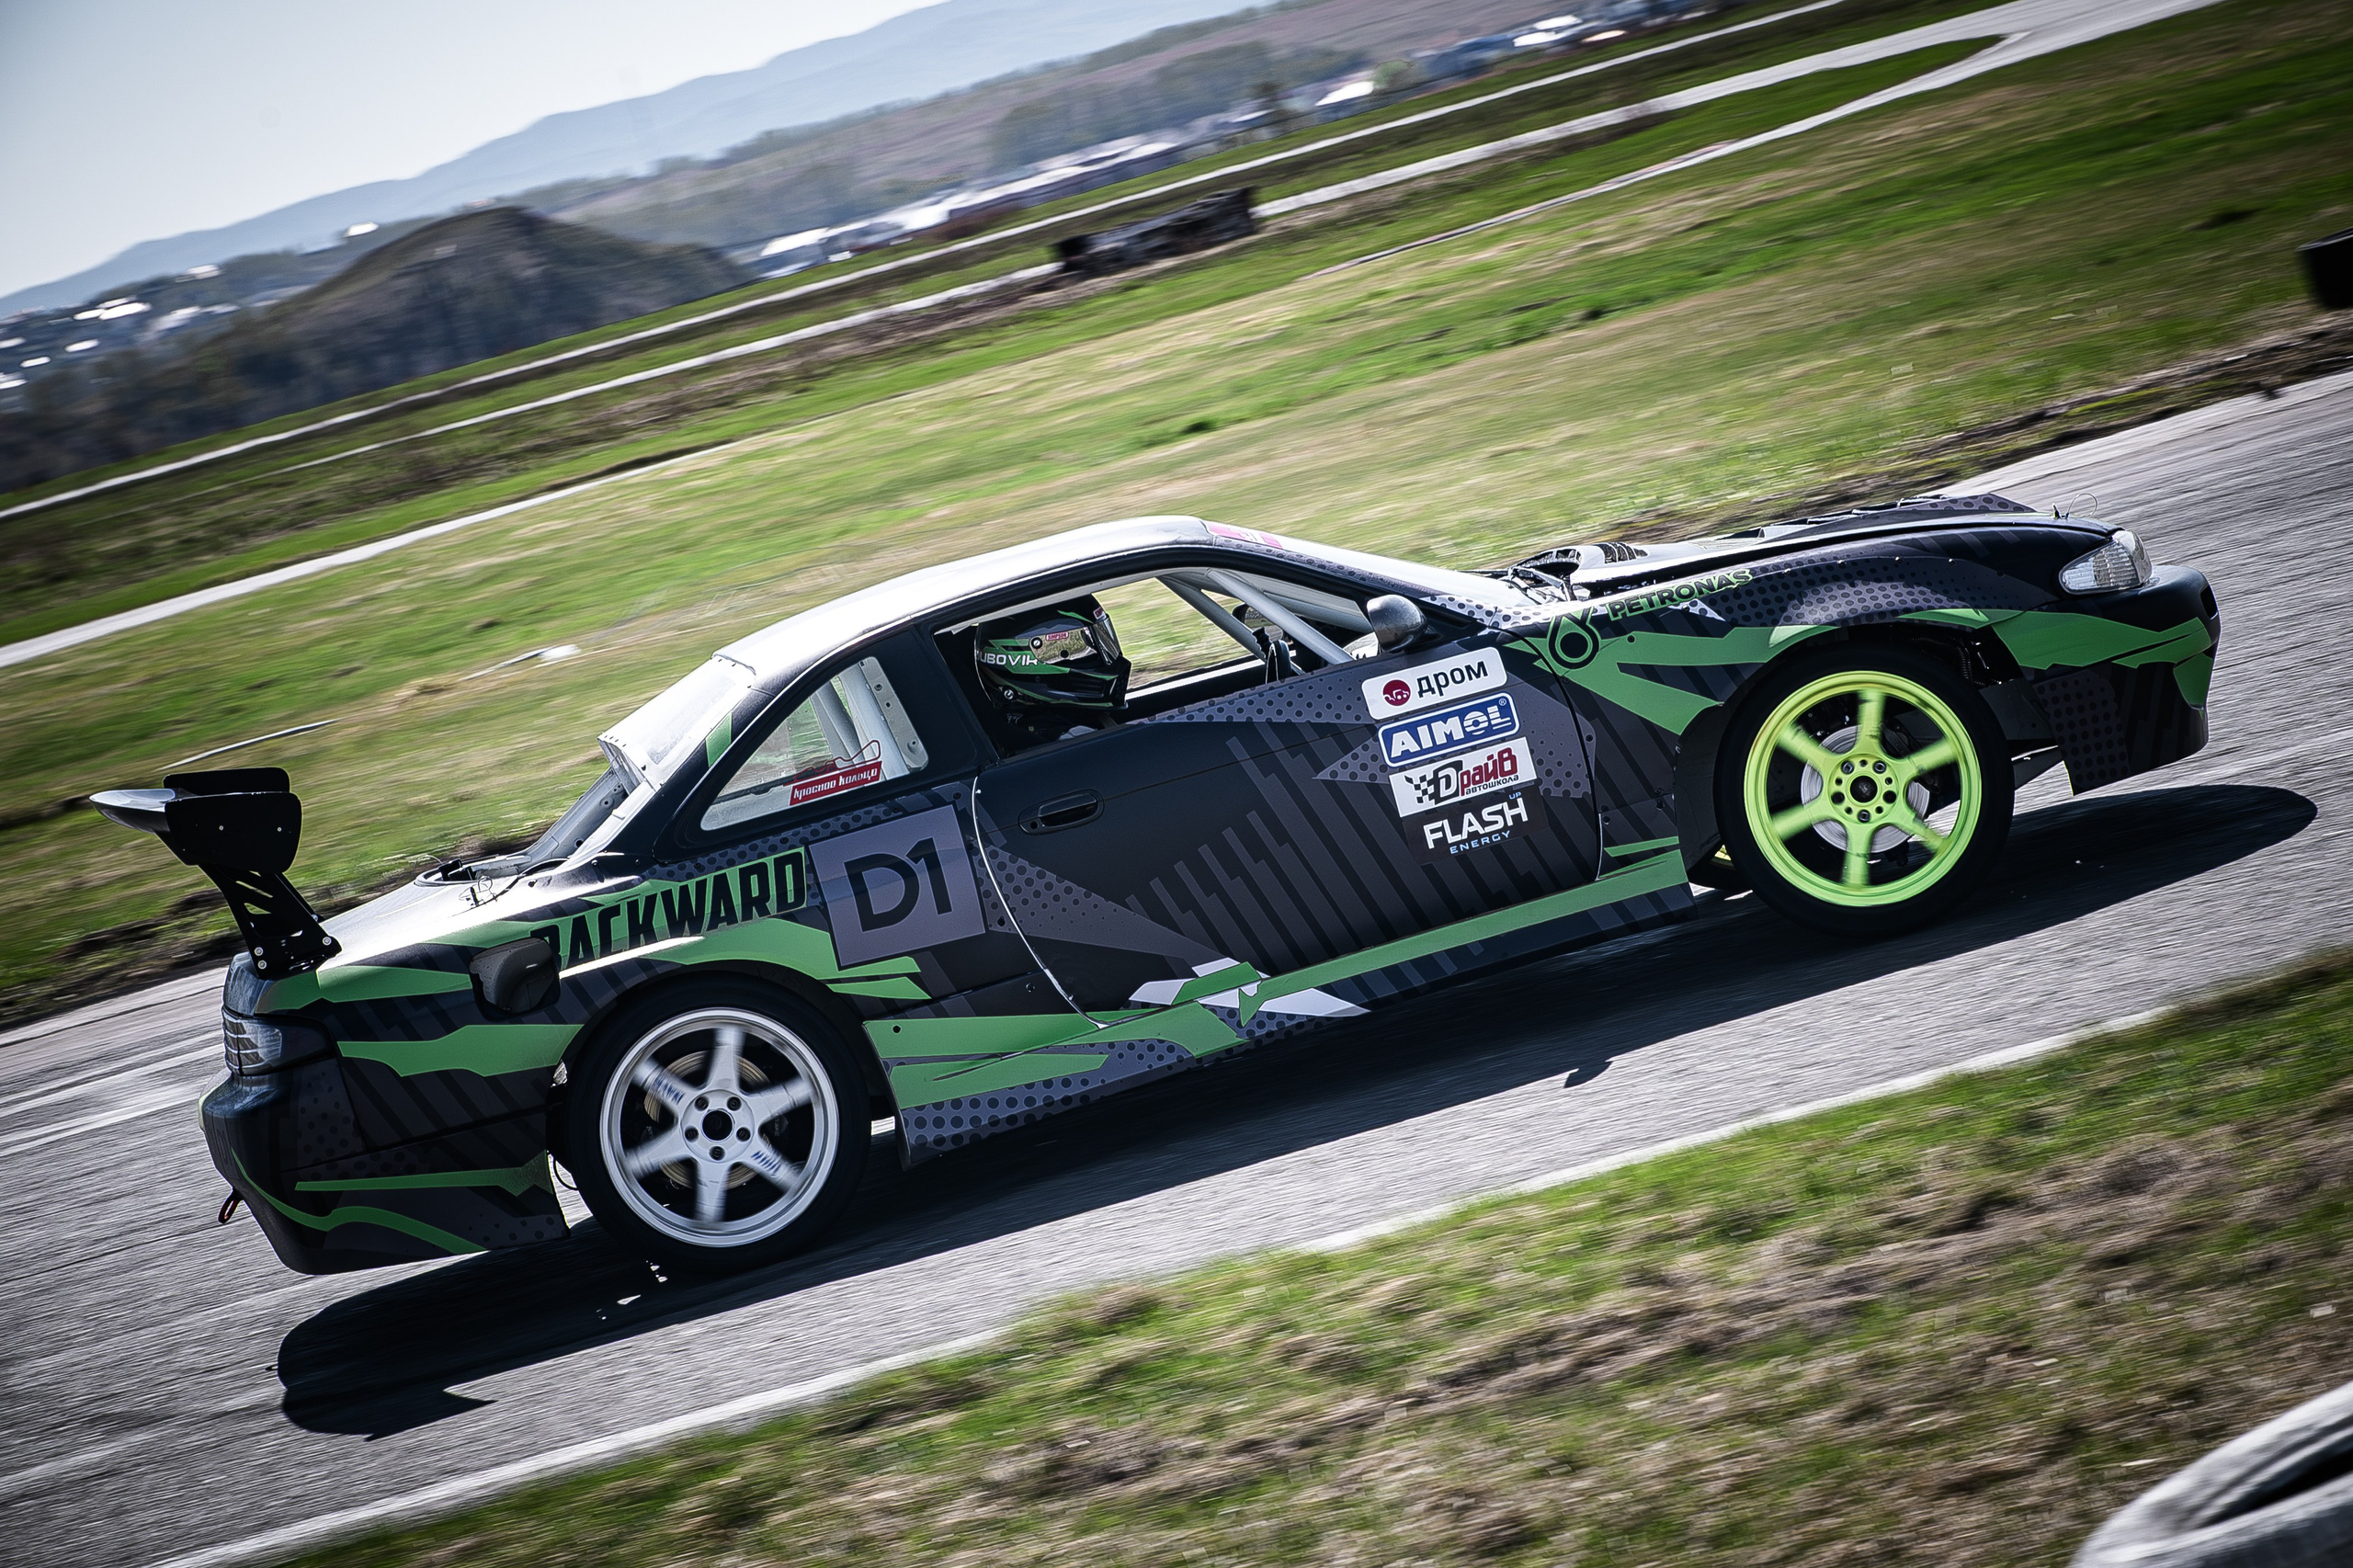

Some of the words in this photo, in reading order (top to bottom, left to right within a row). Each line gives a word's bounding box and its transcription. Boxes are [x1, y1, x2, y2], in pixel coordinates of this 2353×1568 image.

[1608, 570, 1751, 619] PETRONAS
[1416, 661, 1488, 699] дром
[1465, 774, 1519, 795] автошкола
[1508, 791, 1522, 800] UP
[1423, 797, 1529, 849] FLASH
[1449, 830, 1511, 855] ENERGY
[844, 837, 952, 932] D1
